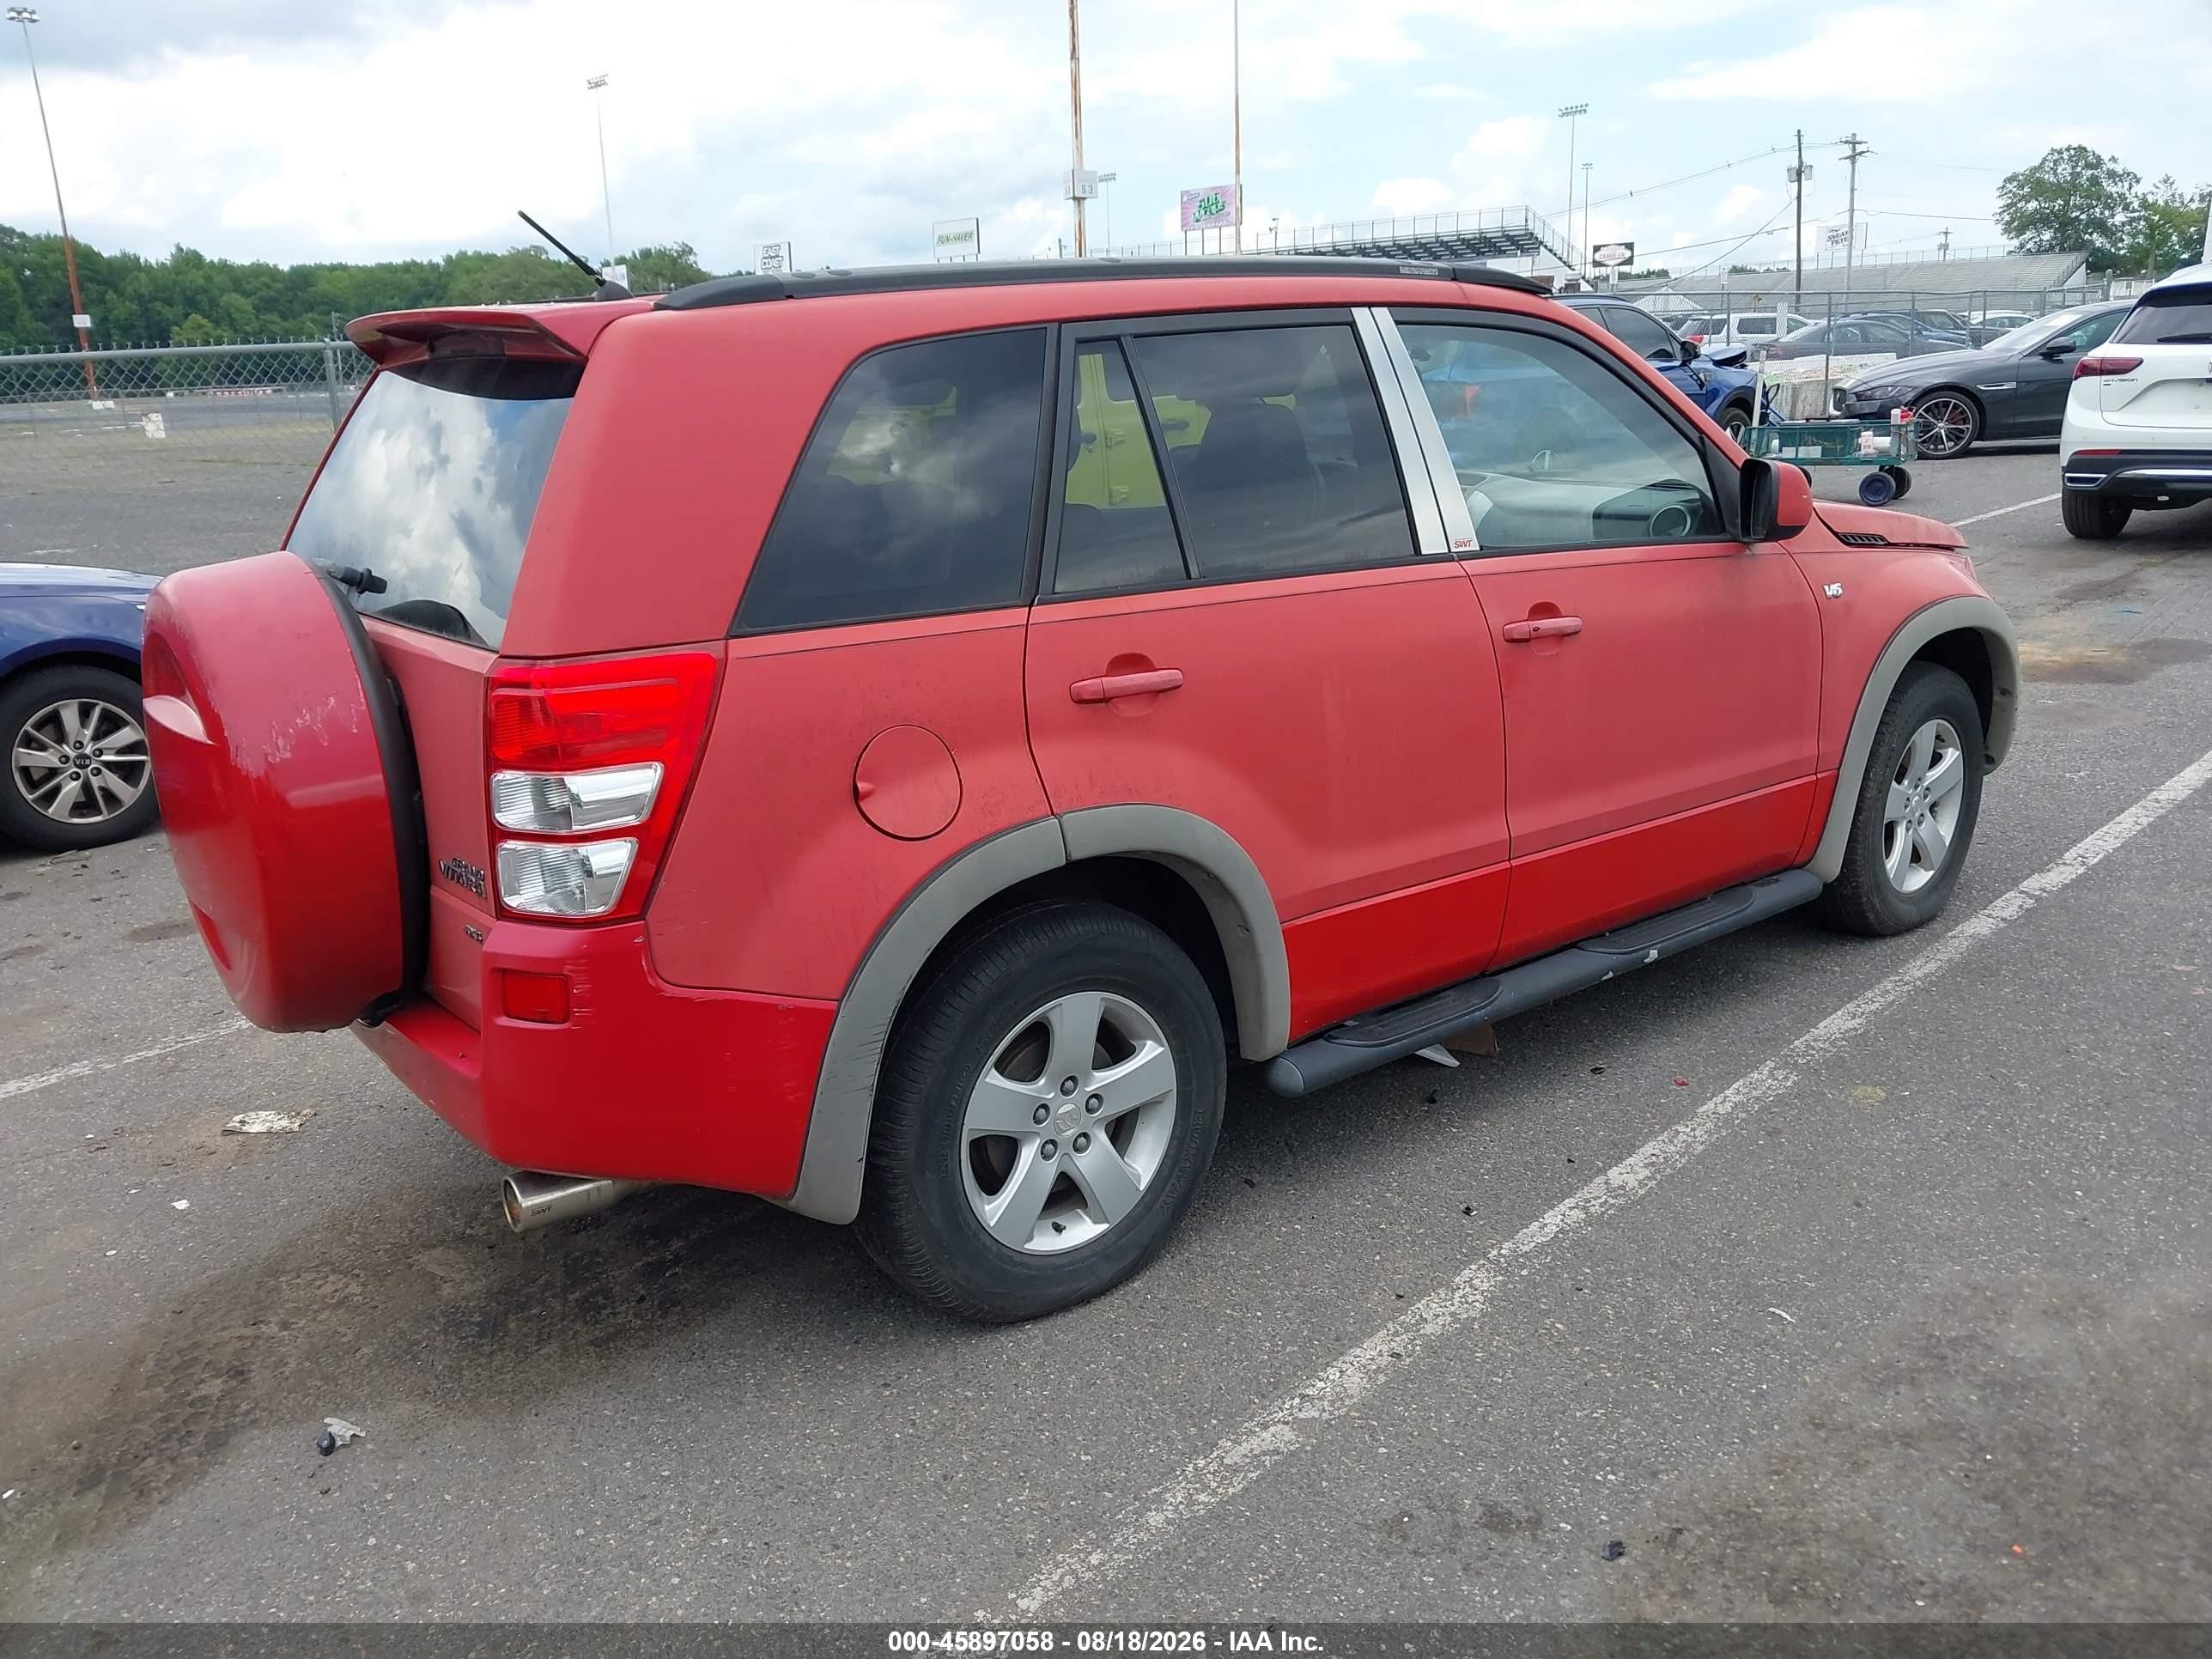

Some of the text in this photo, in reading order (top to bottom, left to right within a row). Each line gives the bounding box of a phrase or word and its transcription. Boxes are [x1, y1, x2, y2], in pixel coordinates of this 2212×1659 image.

[763, 244, 781, 258] EAST
[1454, 539, 1473, 549] SWT
[1822, 581, 1844, 599] V6
[530, 1206, 552, 1217] SWT
